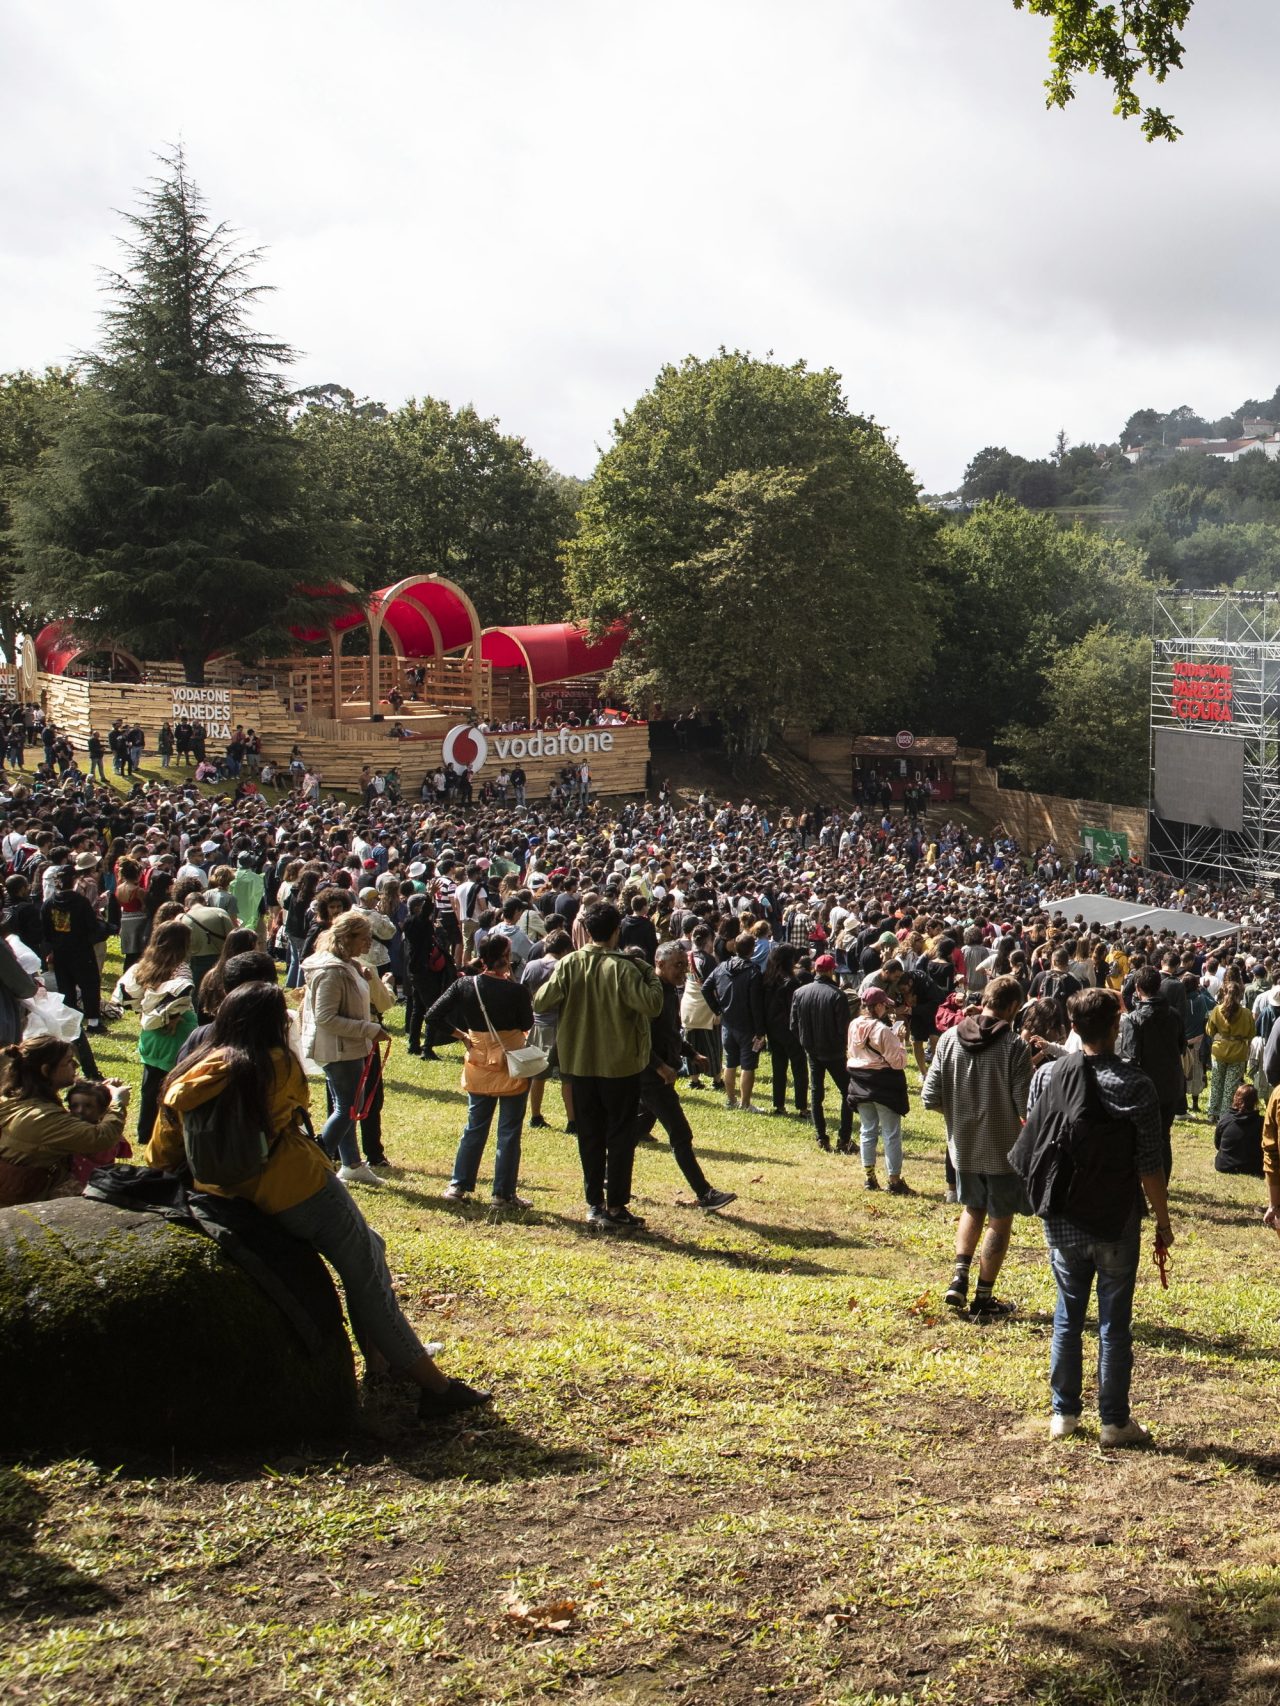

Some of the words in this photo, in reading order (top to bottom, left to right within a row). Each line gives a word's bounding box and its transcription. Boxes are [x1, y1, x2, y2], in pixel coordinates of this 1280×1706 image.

[1173, 663, 1233, 679] VODAFONE
[172, 688, 231, 702] VODAFONE
[1173, 679, 1233, 701] PAREDES
[172, 704, 231, 720] PAREDES
[1177, 699, 1233, 722] COURA
[495, 727, 614, 759] vodafone
